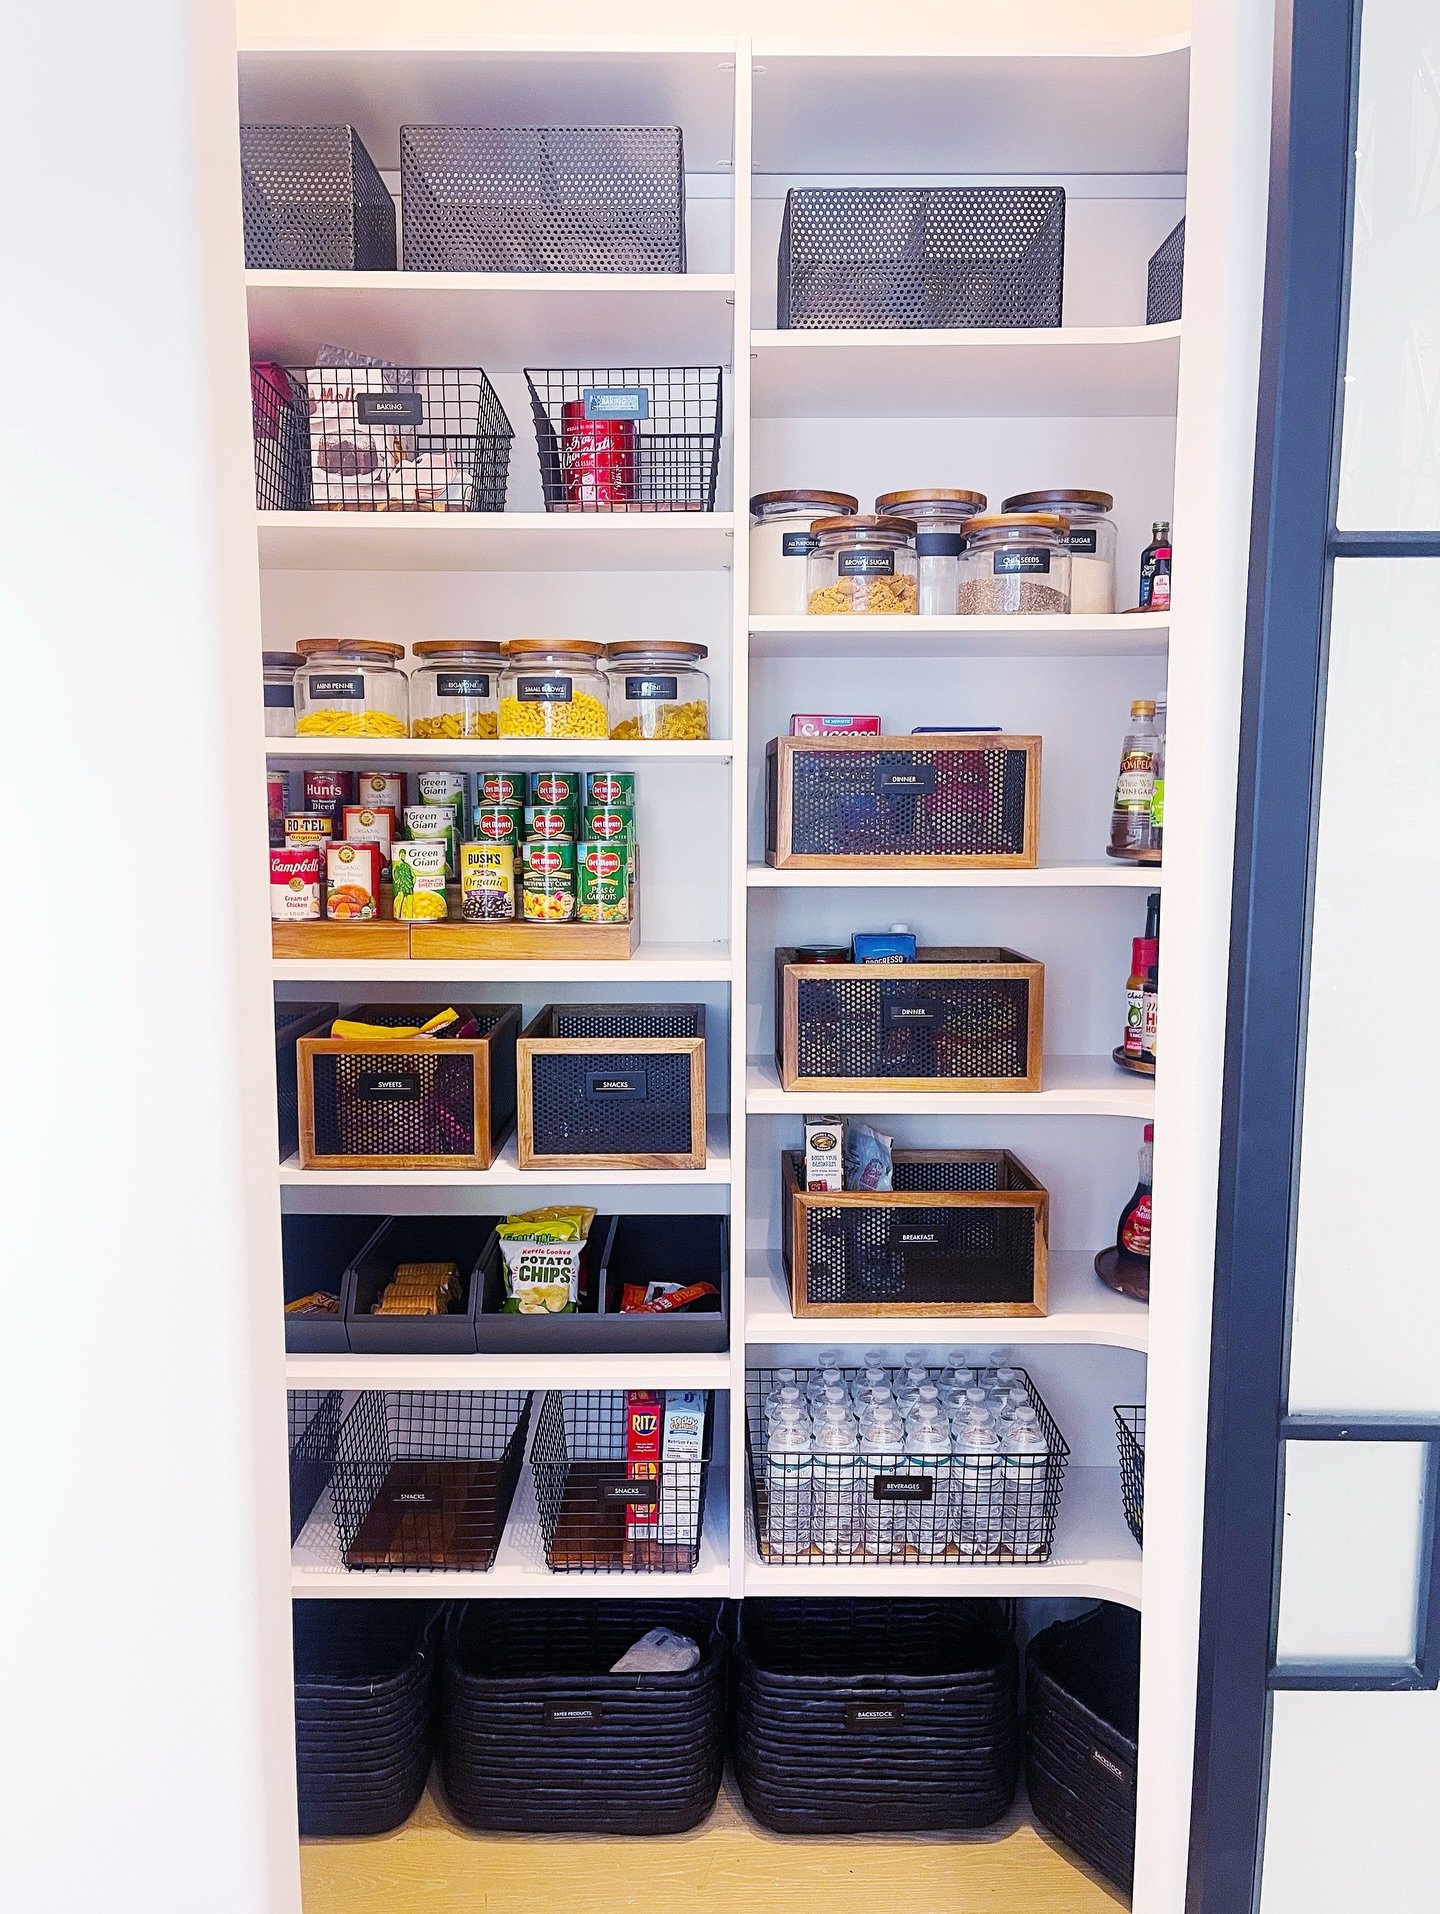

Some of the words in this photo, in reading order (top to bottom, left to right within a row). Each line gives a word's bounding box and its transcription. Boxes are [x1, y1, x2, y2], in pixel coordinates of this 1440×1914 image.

[332, 682, 354, 690] PENNE
[421, 778, 447, 786] Green
[423, 786, 447, 795] Giant
[408, 811, 437, 820] Green
[411, 820, 438, 829] Giant
[408, 848, 438, 857] Green
[412, 857, 439, 866] Giant
[468, 853, 502, 865] BUSH'S
[465, 877, 505, 888] Organic
[520, 1255, 572, 1266] POTATO
[519, 1265, 571, 1284] CHIPS
[632, 1414, 657, 1432] RITZ
[671, 1415, 699, 1426] Teddy
[1094, 1750, 1123, 1778] BACKSTOCK
